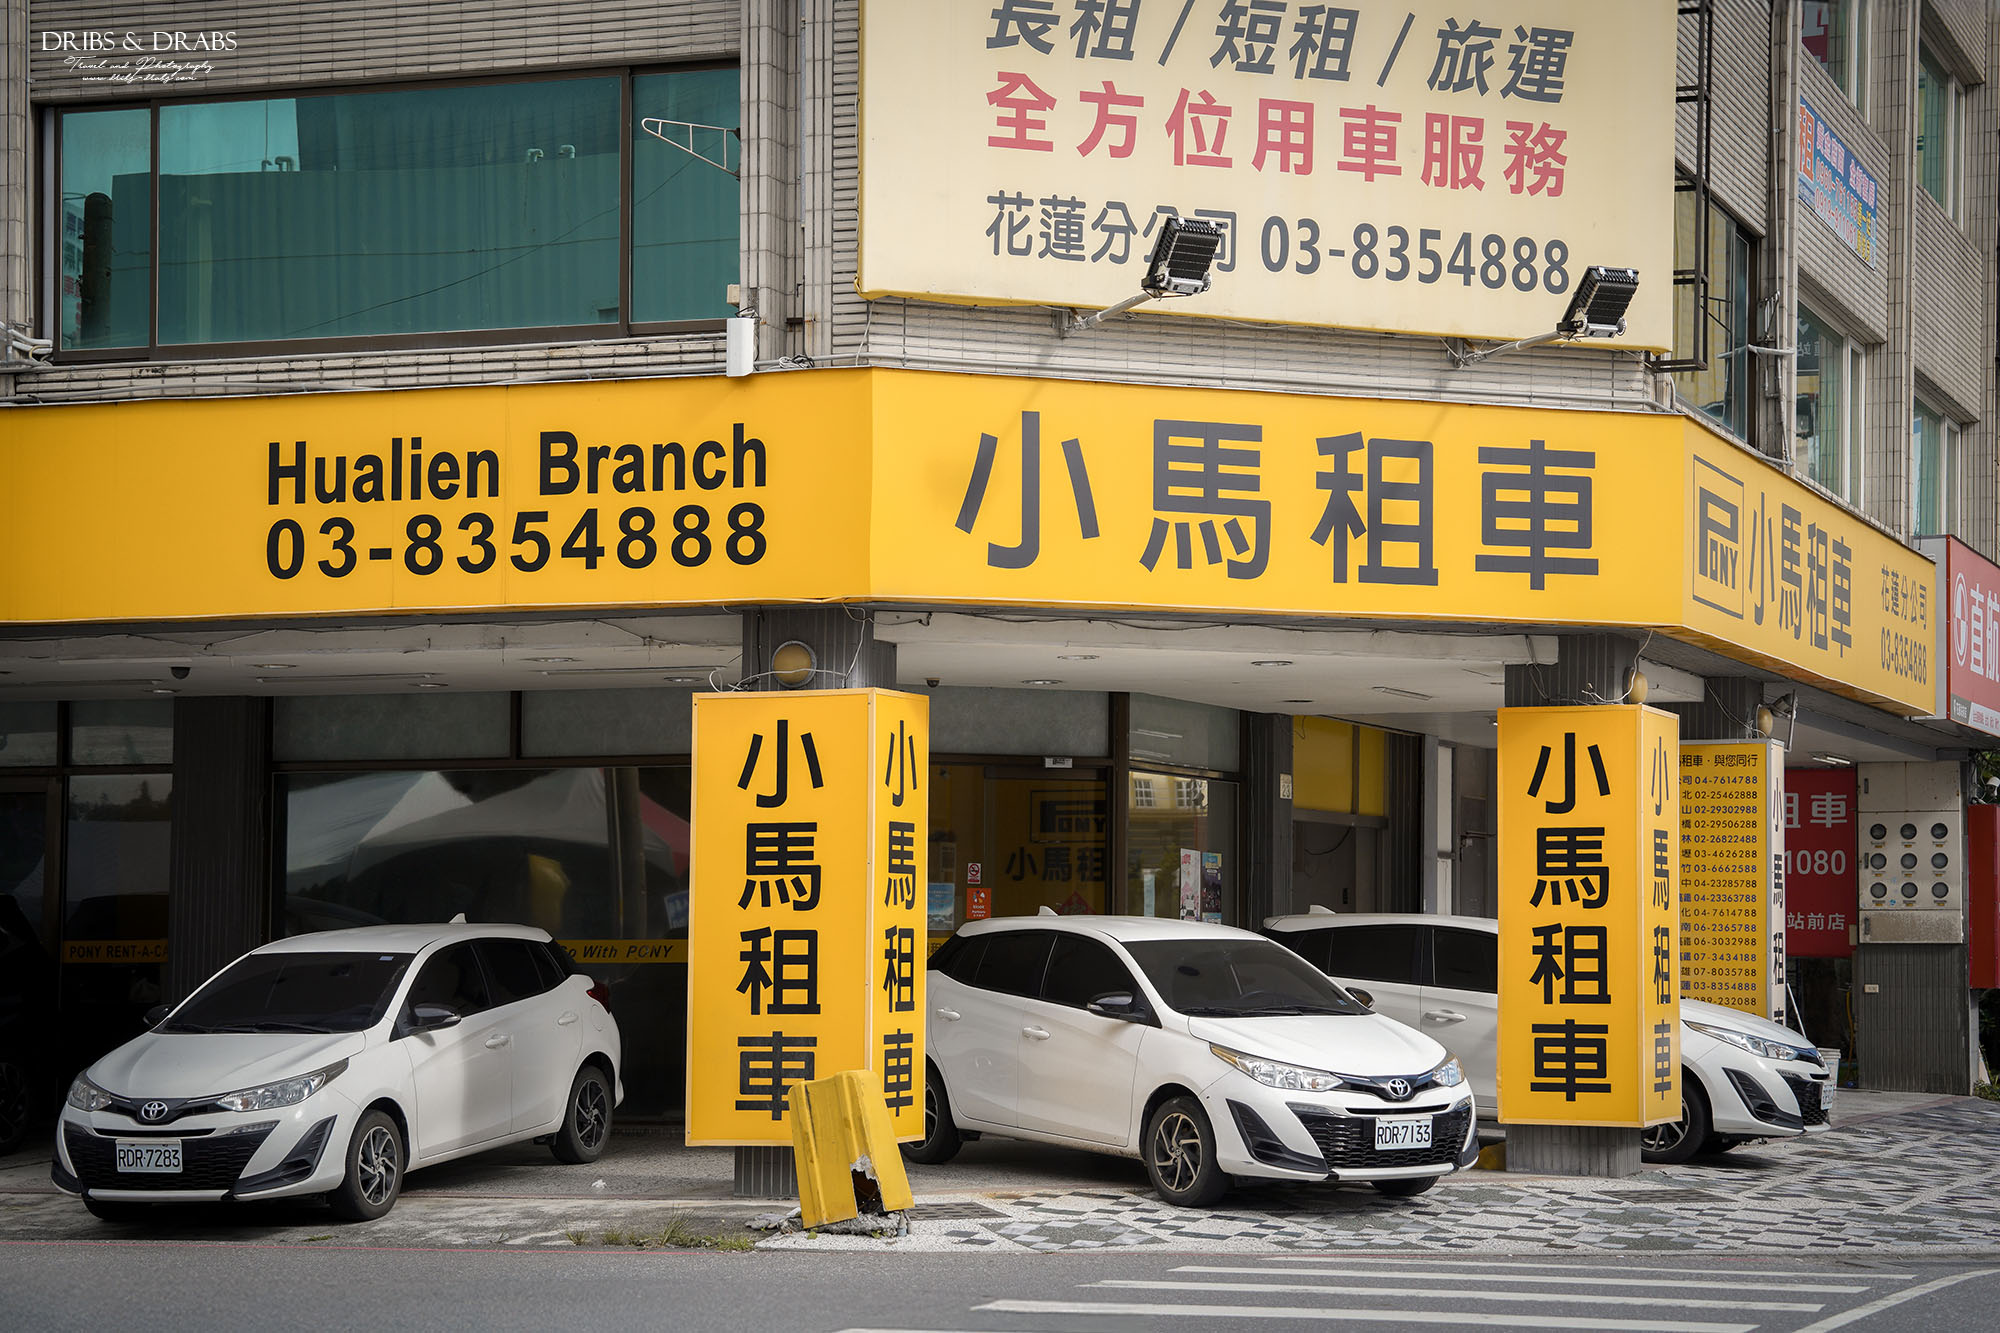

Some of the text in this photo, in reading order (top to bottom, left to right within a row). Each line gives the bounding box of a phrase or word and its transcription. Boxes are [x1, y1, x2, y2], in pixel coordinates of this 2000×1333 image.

[986, 71, 1569, 198] 全方位用車服務
[1259, 216, 1570, 295] 03-8354888
[268, 423, 766, 505] Hualien Branch
[954, 410, 1600, 591] 小馬租車
[266, 502, 768, 580] 03-8354888
[1699, 486, 1739, 590] PONY
[1748, 491, 1852, 658] 小馬租車
[1881, 564, 1927, 630] 花蓮分公司
[1881, 627, 1927, 686] 03-8354888
[1679, 754, 1758, 767] 租車·與您同行
[1679, 776, 1758, 785] 司 04-7614788
[1682, 790, 1758, 800] 北 02-25462888
[1681, 805, 1758, 815] 山 02-29302988
[1694, 820, 1758, 829] 02-29506288
[1681, 834, 1758, 844] 林 02-26822488
[1694, 849, 1758, 858] 03-4626288
[1681, 864, 1758, 873] 竹 03-6662588
[1784, 850, 1846, 875] 1080
[1681, 879, 1758, 889] 中 04-23285788
[1694, 893, 1758, 902] 04-23363788
[885, 720, 917, 1117] 小馬租車
[1527, 732, 1612, 1102] 小馬租車
[1651, 736, 1672, 1101] 小馬租車
[1681, 908, 1757, 918] 化 04-7614788
[736, 719, 824, 1121] 小馬租車
[1787, 912, 1845, 930] 站前店
[1694, 923, 1757, 932] 06-2365788
[1694, 937, 1757, 946] 06-3032988
[70, 945, 102, 958] PONY
[583, 945, 617, 958] With
[626, 945, 673, 958] PONY
[1694, 952, 1757, 961] 07-3434188
[1694, 967, 1757, 976] 07-8035788
[1694, 982, 1757, 991] 03-8354888
